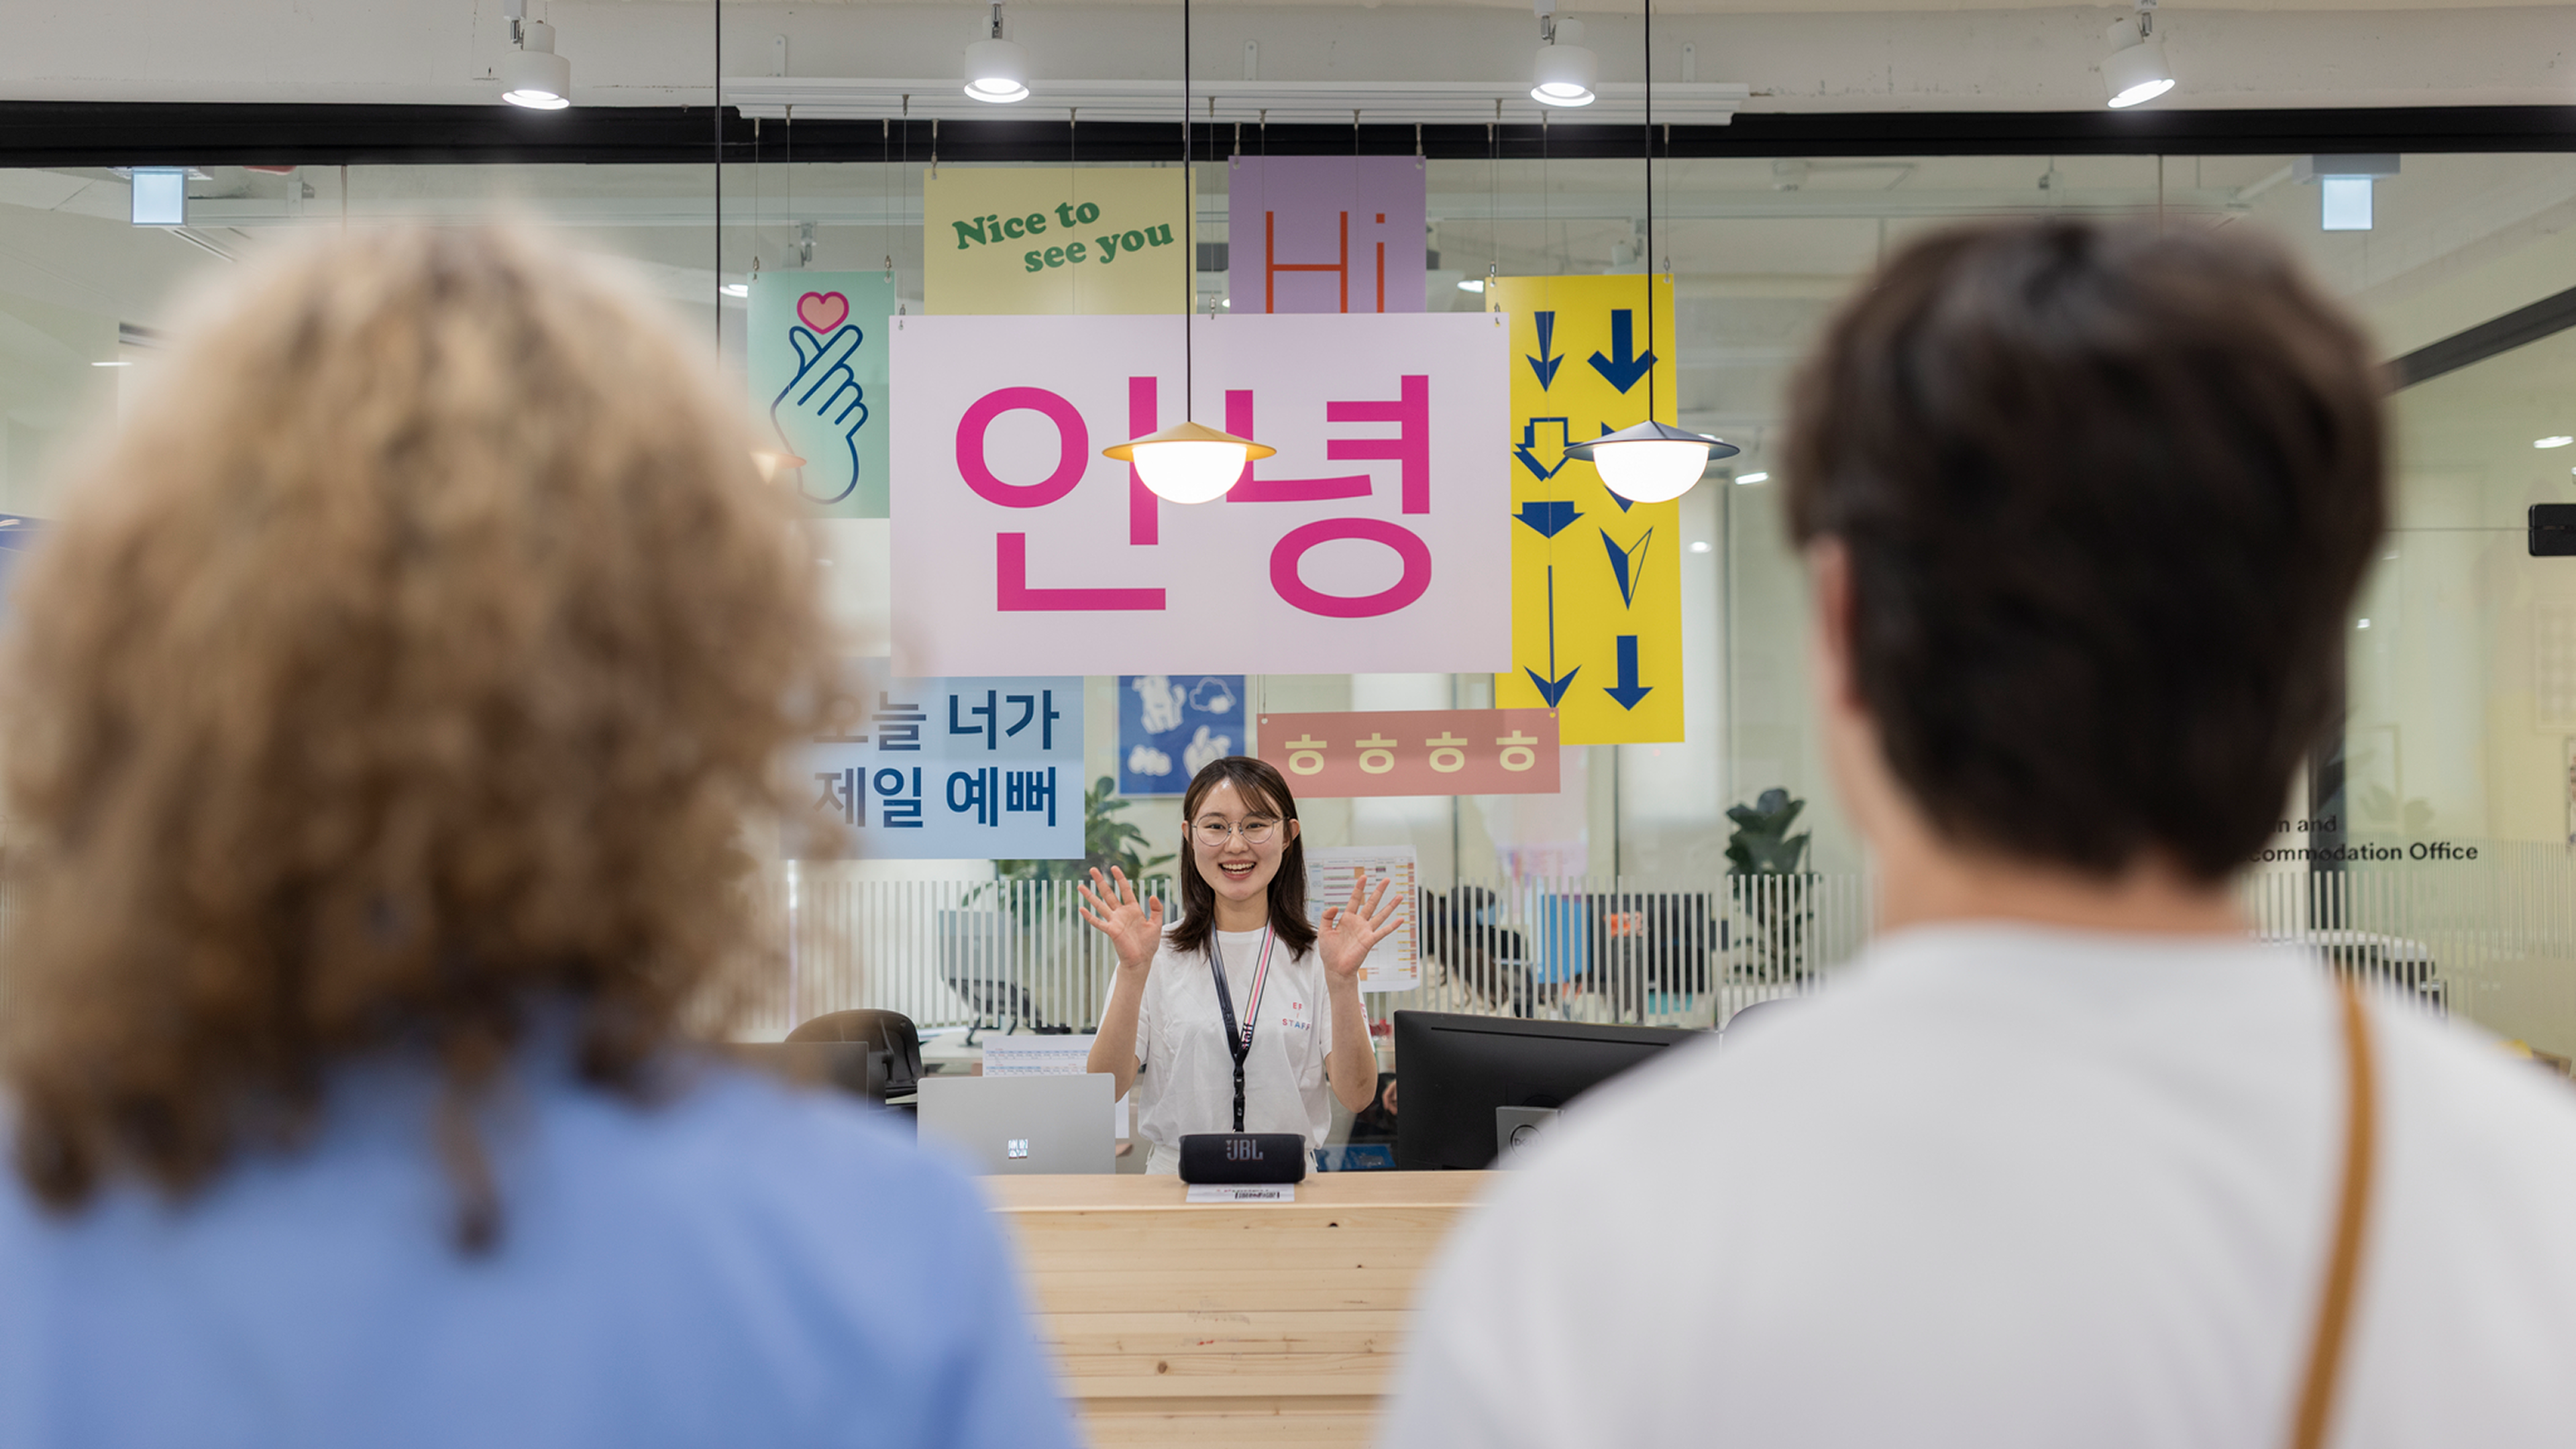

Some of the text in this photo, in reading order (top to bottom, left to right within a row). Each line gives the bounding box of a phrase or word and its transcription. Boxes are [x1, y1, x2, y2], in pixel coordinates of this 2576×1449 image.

[952, 202, 1100, 250] Nice to
[1024, 223, 1175, 273] see you
[1266, 211, 1385, 313] Hi
[956, 375, 1431, 618] 안녕
[949, 690, 1060, 751] 너가
[812, 767, 1057, 828] 제일 예뻐
[2298, 816, 2337, 833] and
[2410, 842, 2479, 861] Office
[1282, 1018, 1311, 1030] STAFF
[1226, 1139, 1264, 1161] JBL
